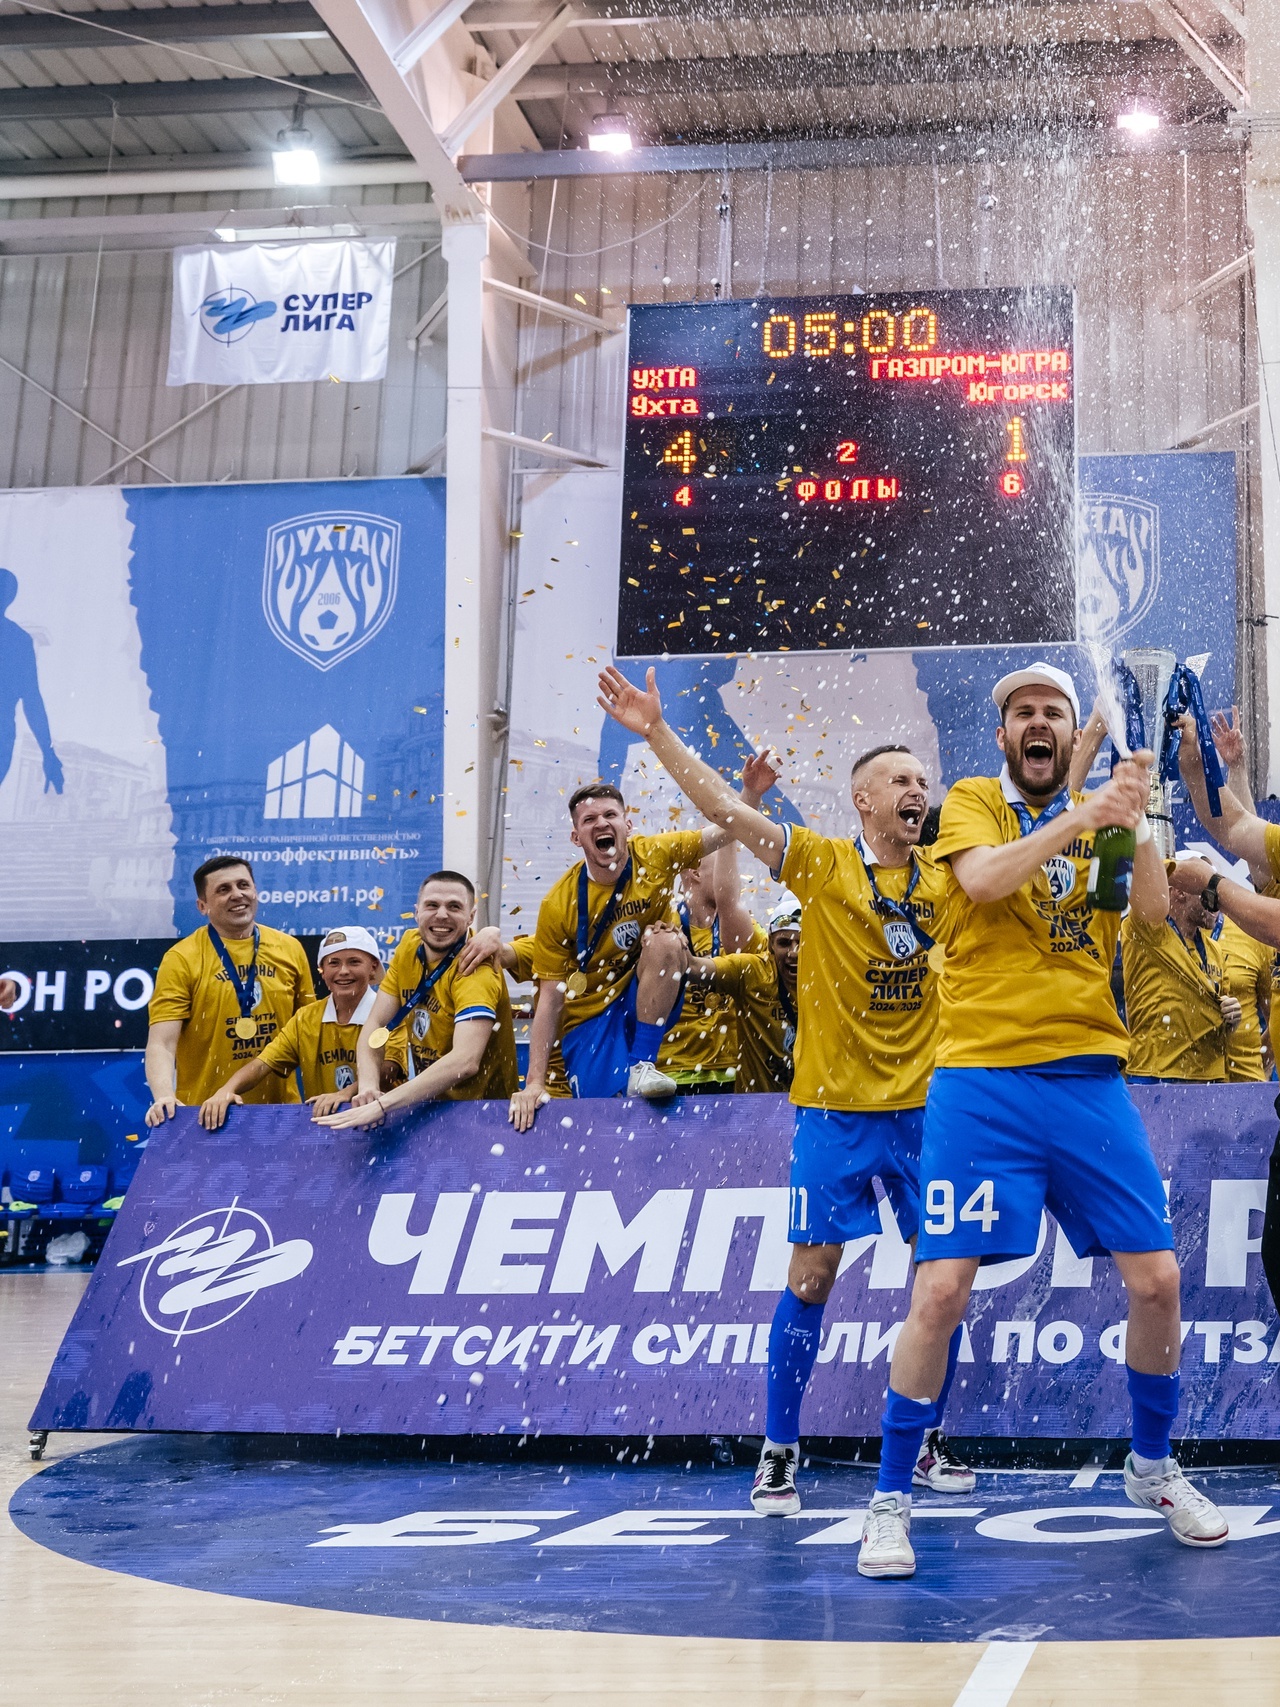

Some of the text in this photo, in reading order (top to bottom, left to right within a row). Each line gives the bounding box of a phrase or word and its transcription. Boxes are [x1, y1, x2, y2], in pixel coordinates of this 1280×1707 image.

[283, 291, 373, 312] СУПЕР
[280, 312, 355, 333] ЛИГА
[763, 307, 937, 358] 05:00
[871, 351, 1068, 379] ГАЗПРОМ-ЮГРА
[632, 367, 696, 389] УХТА
[968, 381, 1068, 402] Югорск
[631, 397, 698, 416] Ухта
[1006, 416, 1027, 461] 1
[664, 430, 697, 475] 4
[837, 442, 858, 463] 2
[797, 477, 897, 501] ФОЛЫ
[1004, 473, 1020, 494] 6
[675, 487, 692, 507] 4
[1078, 505, 1129, 539] ХТА
[296, 523, 370, 557] УХТА
[317, 592, 341, 605] 2006
[258, 885, 385, 908] оверка11.рф
[865, 966, 928, 985] СУПЕР
[870, 985, 924, 1000] ЛИГА
[868, 1001, 923, 1012] 2024/2025
[923, 1179, 1000, 1235] 94
[332, 1324, 622, 1366] БЕТСИТИ
[991, 1320, 1083, 1364] ПО
